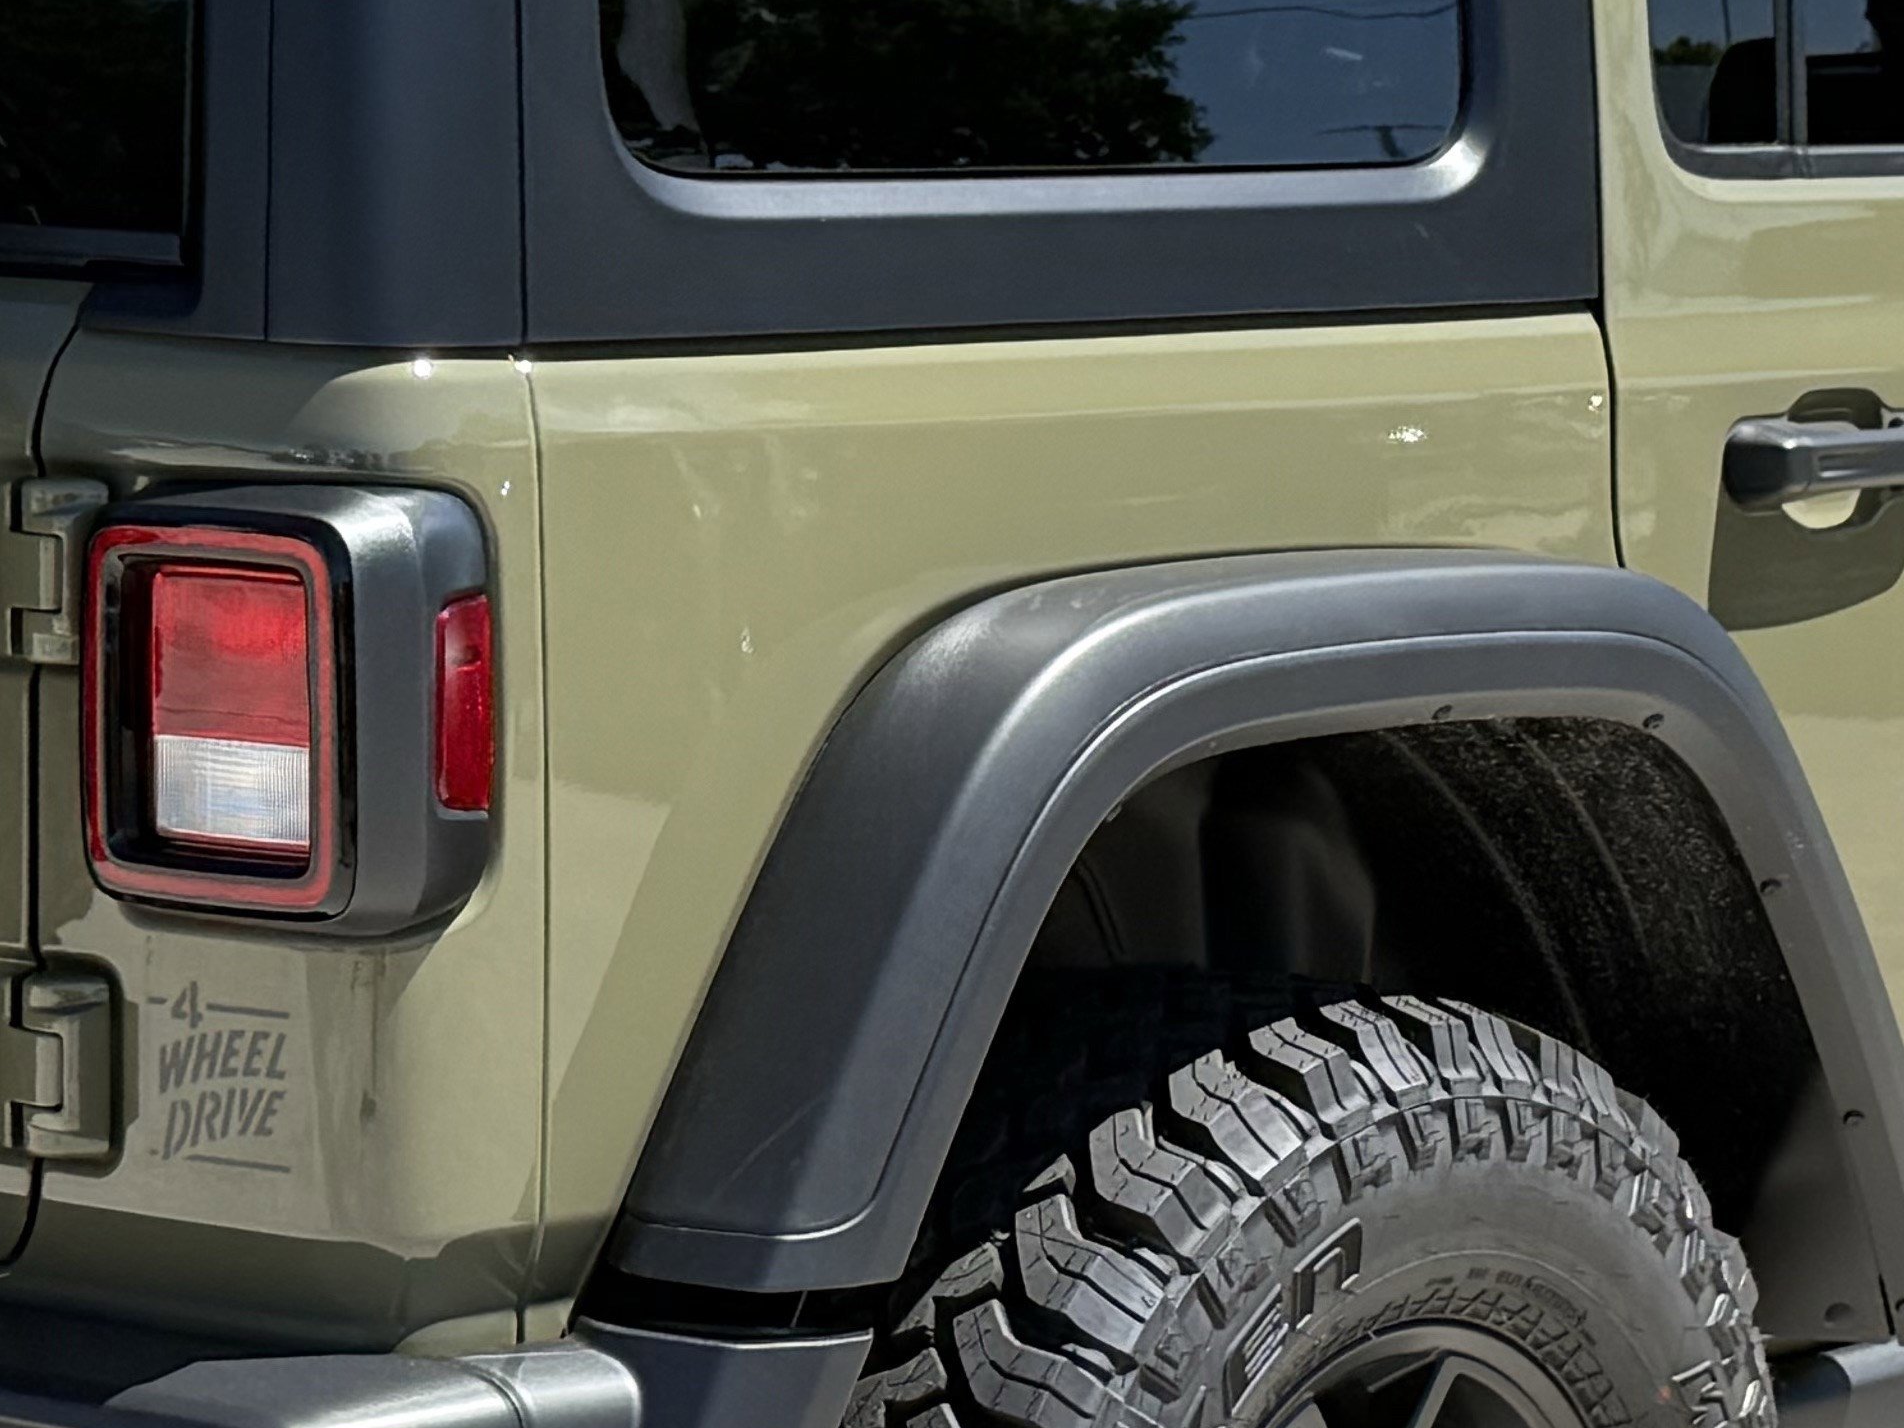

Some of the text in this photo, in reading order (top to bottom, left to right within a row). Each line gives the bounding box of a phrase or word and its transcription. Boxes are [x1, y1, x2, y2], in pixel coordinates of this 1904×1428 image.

[170, 980, 203, 1029] 4
[159, 1029, 287, 1095] WHEEL
[161, 1087, 287, 1160] DRIVE
